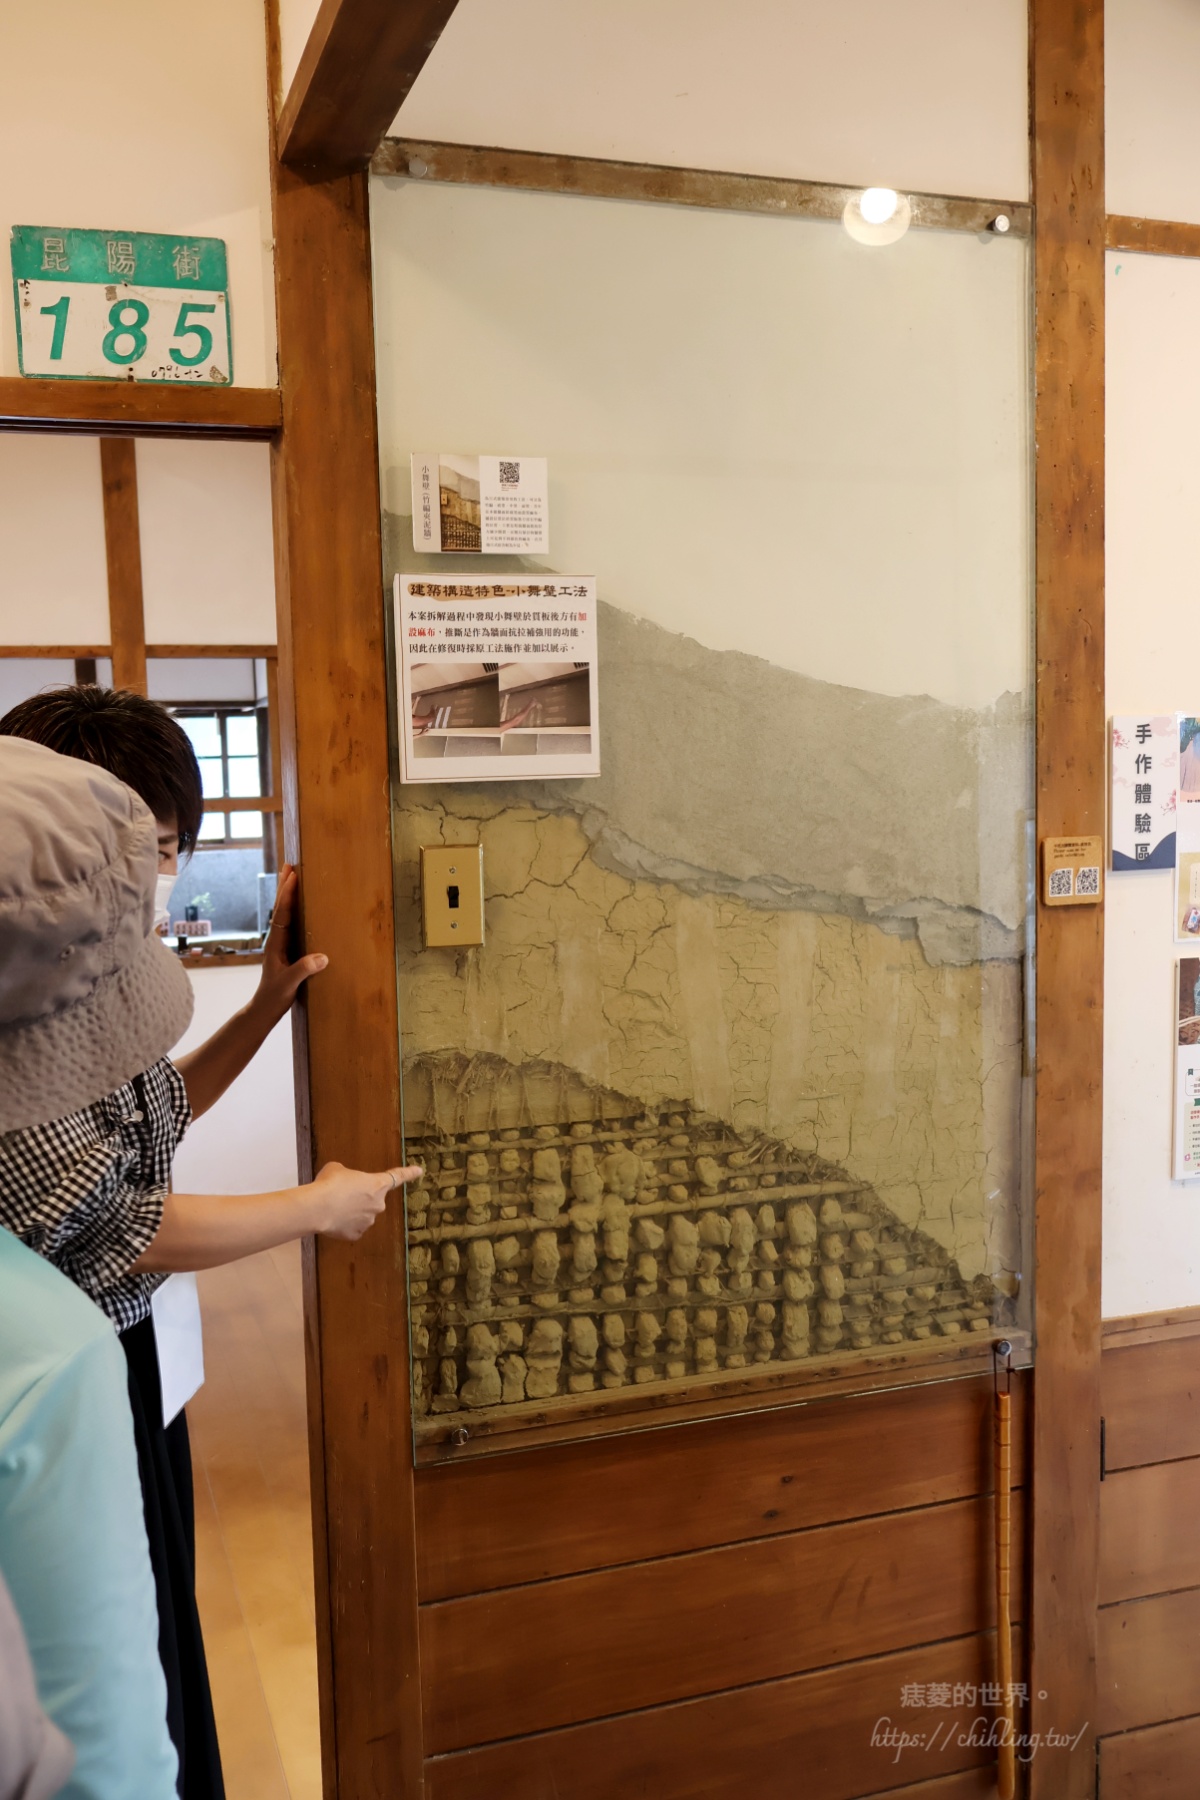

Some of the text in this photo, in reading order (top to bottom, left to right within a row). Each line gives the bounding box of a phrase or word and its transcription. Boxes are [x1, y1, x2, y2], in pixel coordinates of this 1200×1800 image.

[41, 237, 201, 281] 昆陽街
[40, 296, 217, 367] 185
[1134, 723, 1153, 862] 手作體驗區
